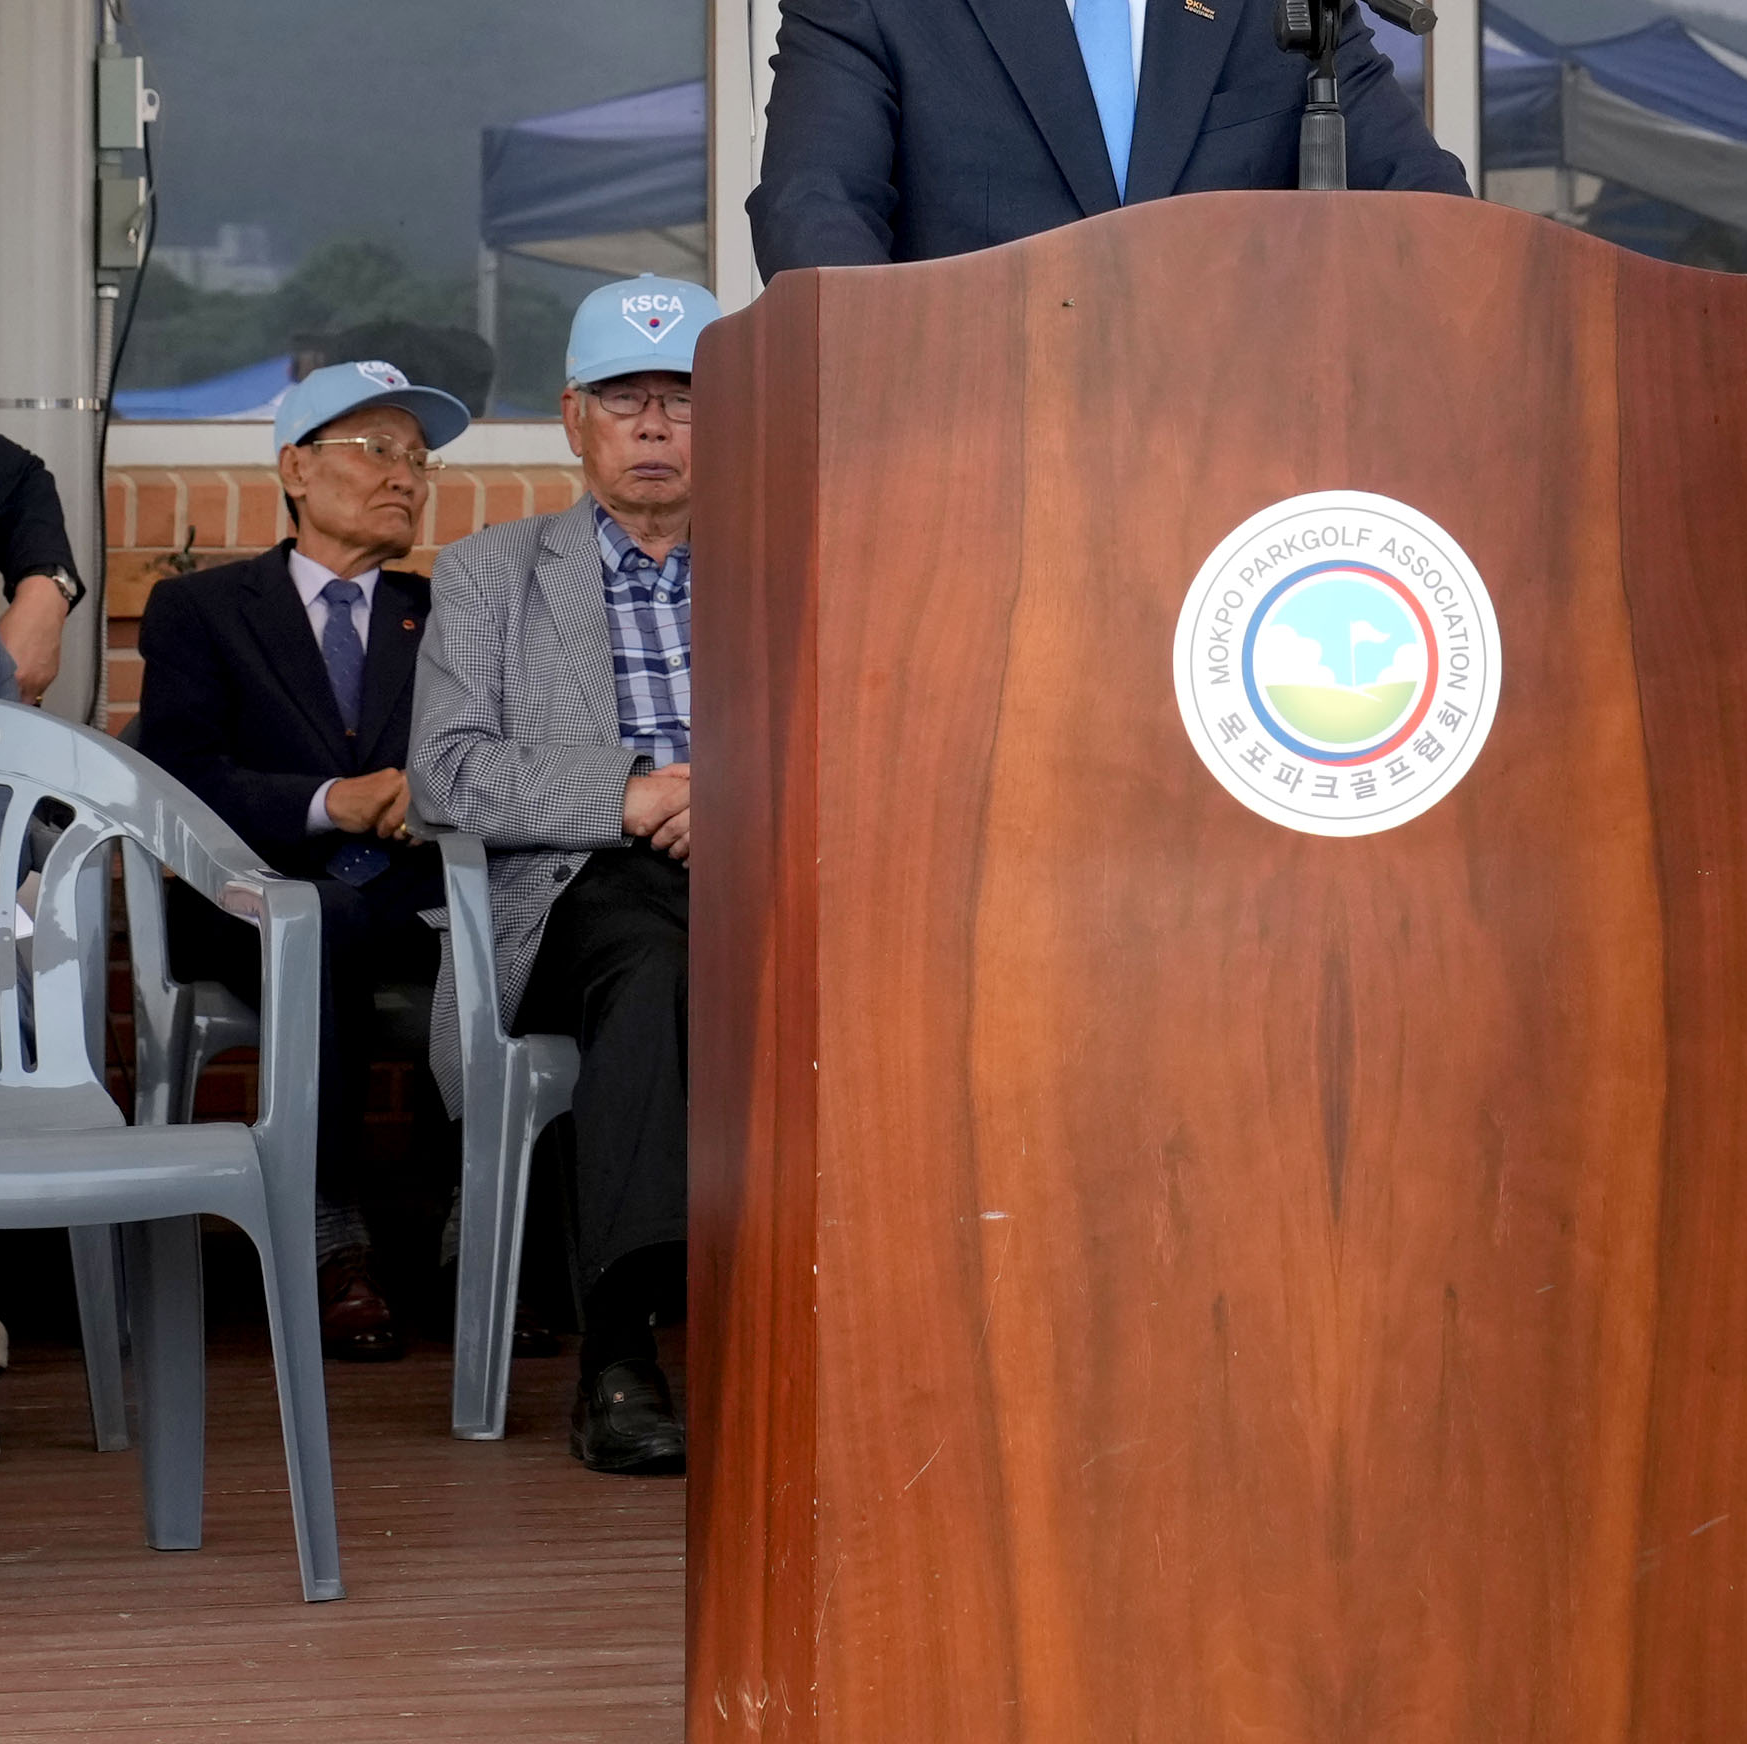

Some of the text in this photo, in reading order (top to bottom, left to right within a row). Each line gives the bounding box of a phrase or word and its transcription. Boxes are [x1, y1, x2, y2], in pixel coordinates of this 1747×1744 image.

[622, 294, 684, 315] KSCA
[1209, 526, 1470, 691] MOKPO PARKGOLF ASSOCIATION
[1217, 700, 1468, 800] 목포파크골프협회
